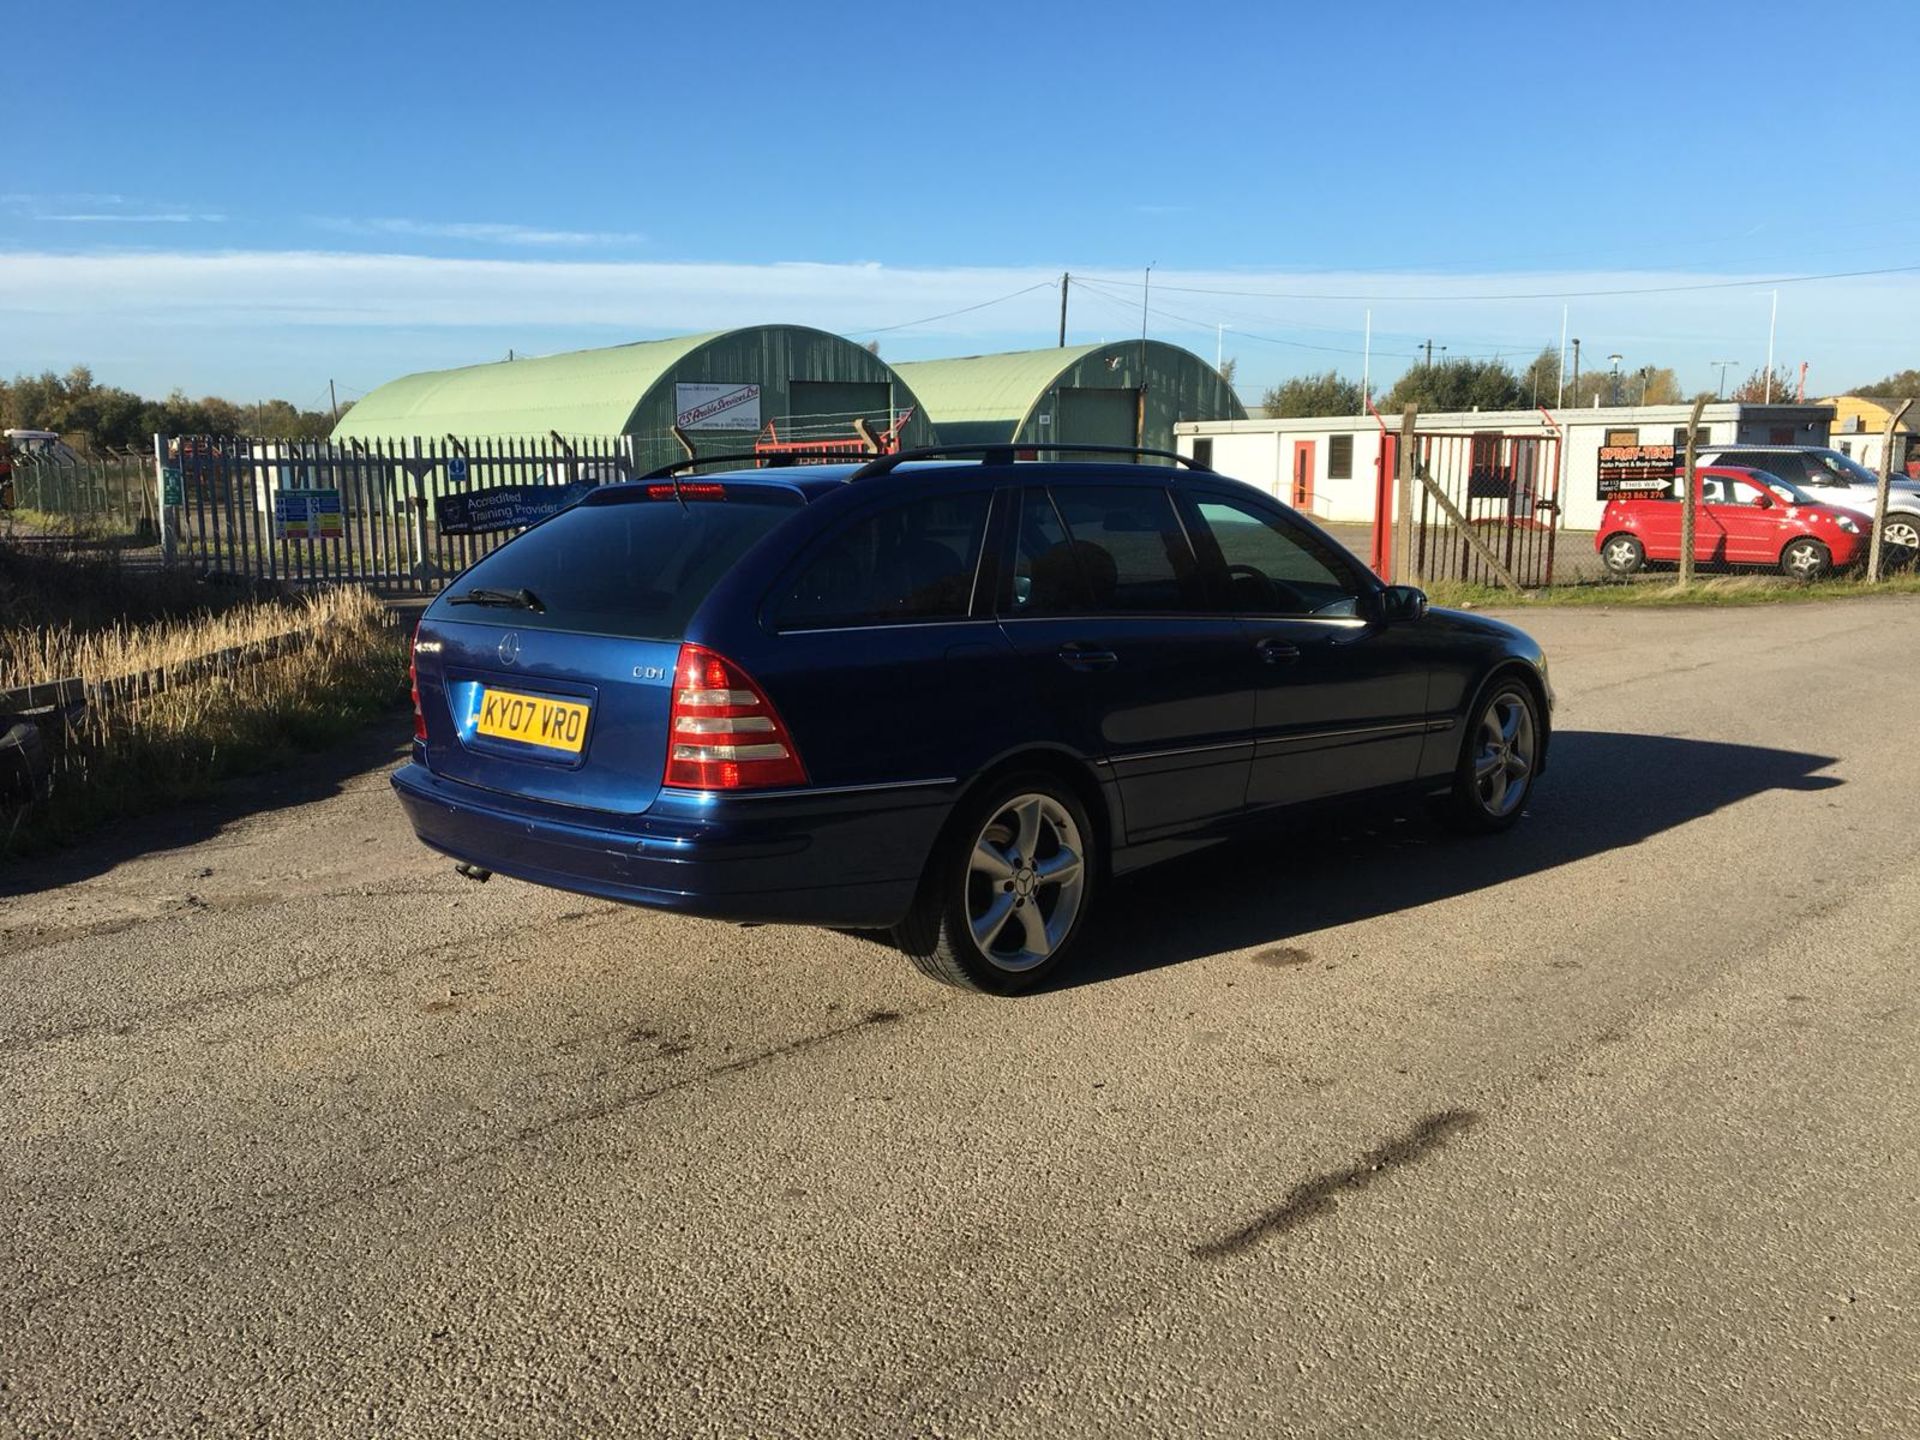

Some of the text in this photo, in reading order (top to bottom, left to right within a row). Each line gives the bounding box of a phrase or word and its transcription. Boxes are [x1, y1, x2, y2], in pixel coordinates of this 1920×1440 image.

[746, 386, 759, 398] Ltd
[1600, 446, 1674, 461] SPRAY-TECH
[468, 492, 522, 509] Accredited
[1650, 491, 1665, 499] 276
[471, 503, 557, 522] Training Provider
[632, 666, 666, 681] CDI
[483, 693, 581, 743] KY07 VRO
